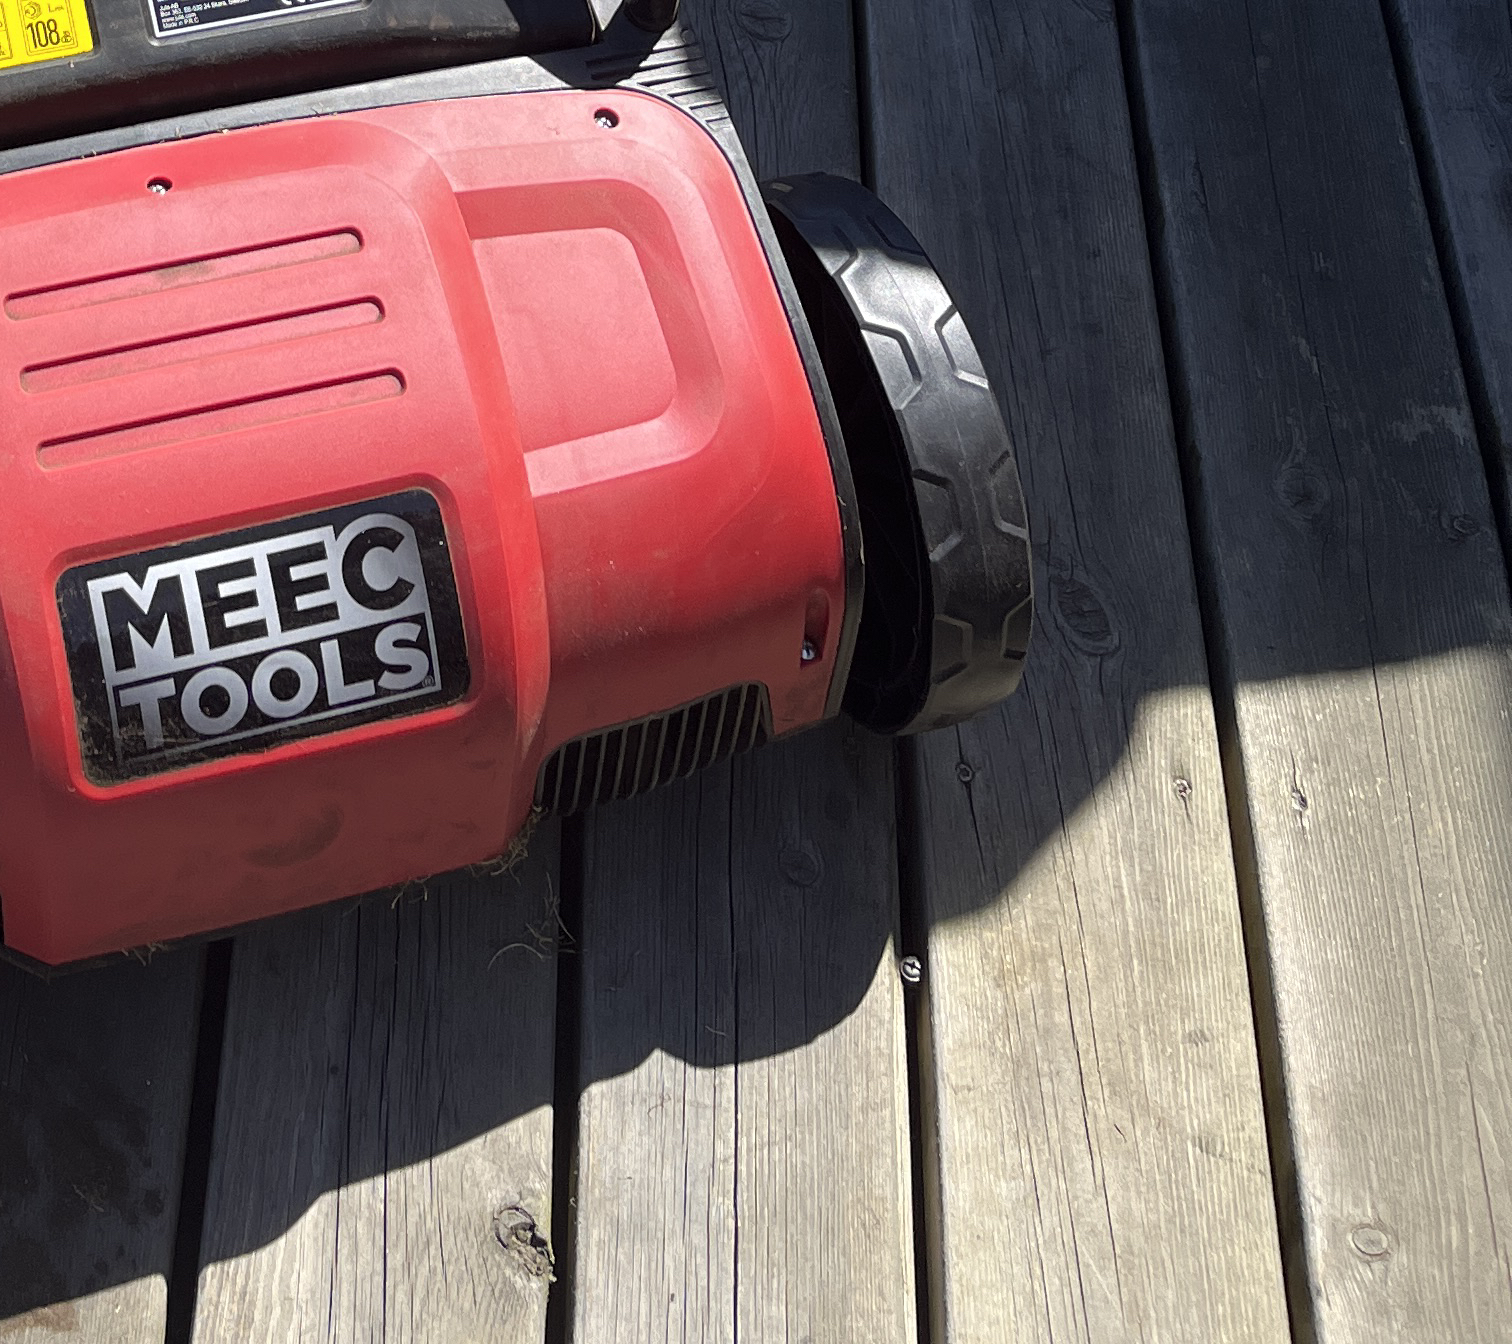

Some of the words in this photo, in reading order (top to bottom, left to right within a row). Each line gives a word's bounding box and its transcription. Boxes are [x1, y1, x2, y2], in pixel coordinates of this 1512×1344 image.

[25, 18, 60, 48] 108
[101, 524, 415, 675] MEEC
[119, 623, 430, 750] TOOLS
